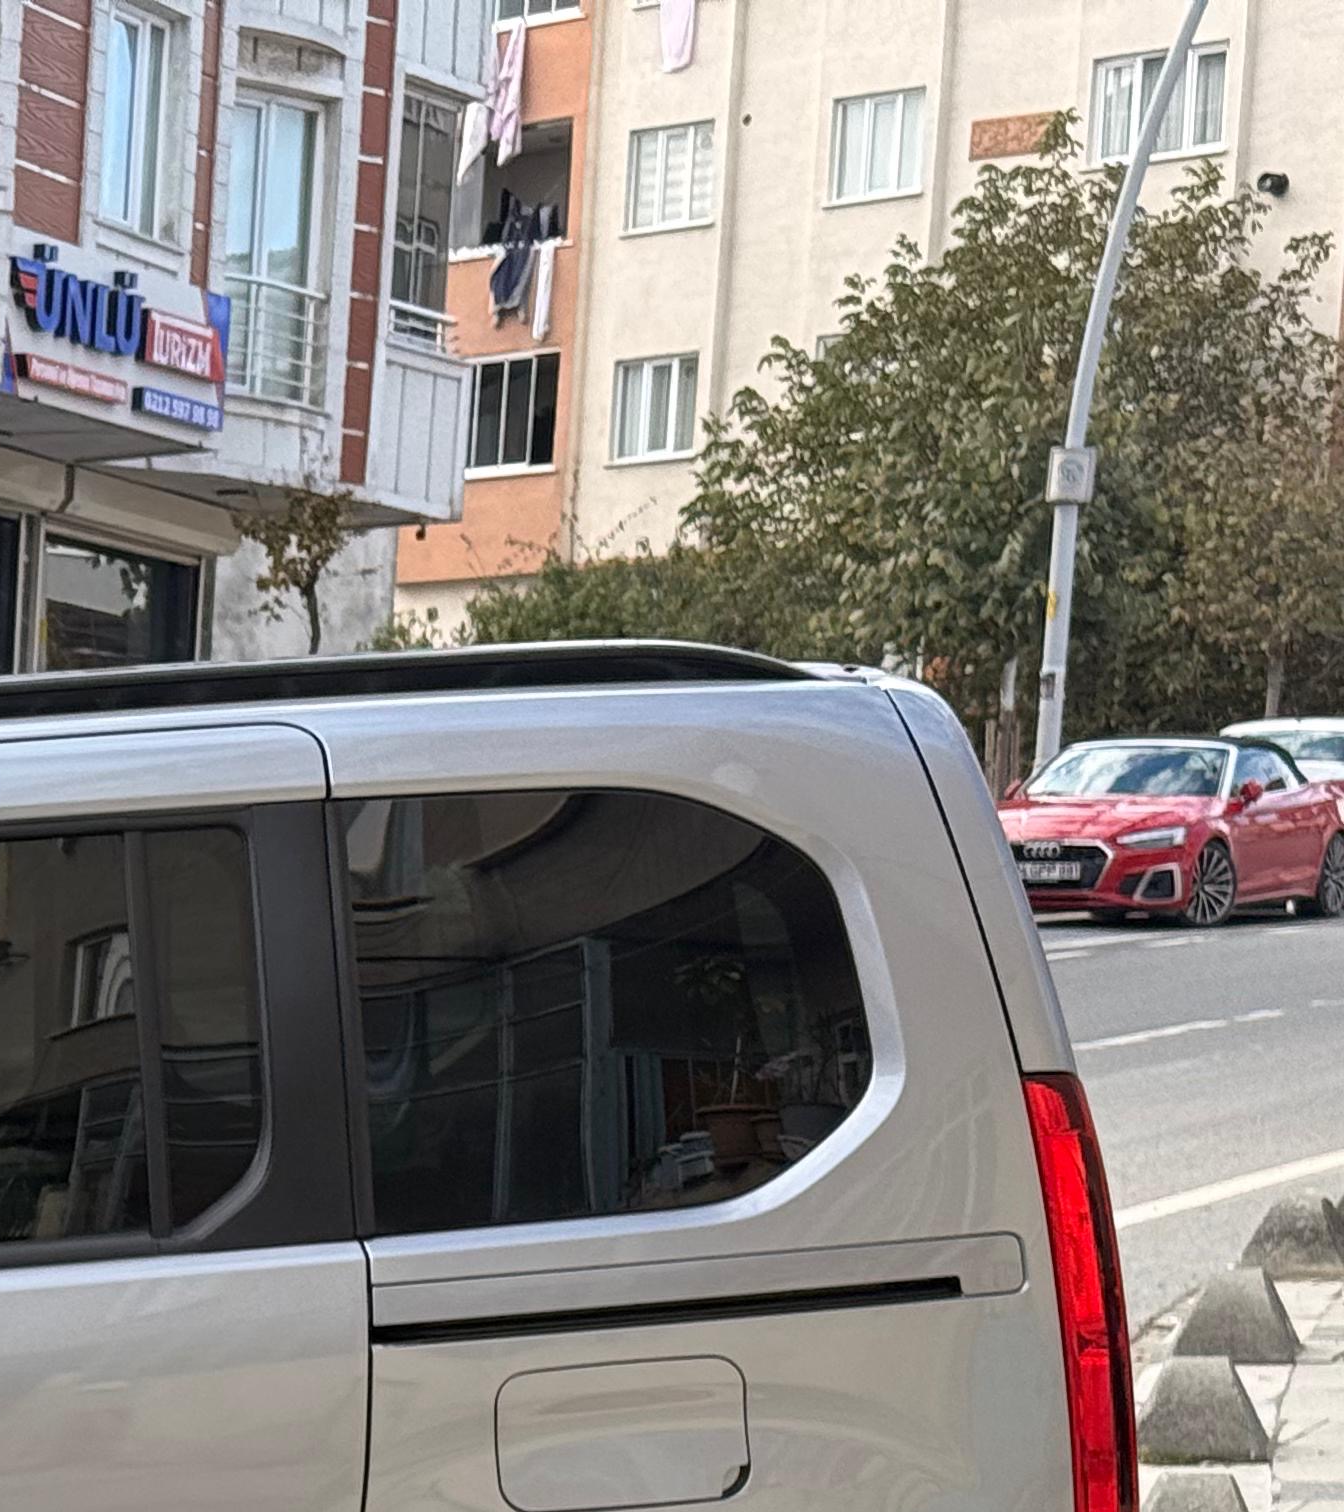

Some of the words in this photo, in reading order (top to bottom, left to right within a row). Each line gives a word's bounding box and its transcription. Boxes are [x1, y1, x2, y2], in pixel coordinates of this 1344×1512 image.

[10, 243, 146, 356] ÜNLÜ
[144, 391, 171, 415] 0212
[172, 398, 192, 421] 597
